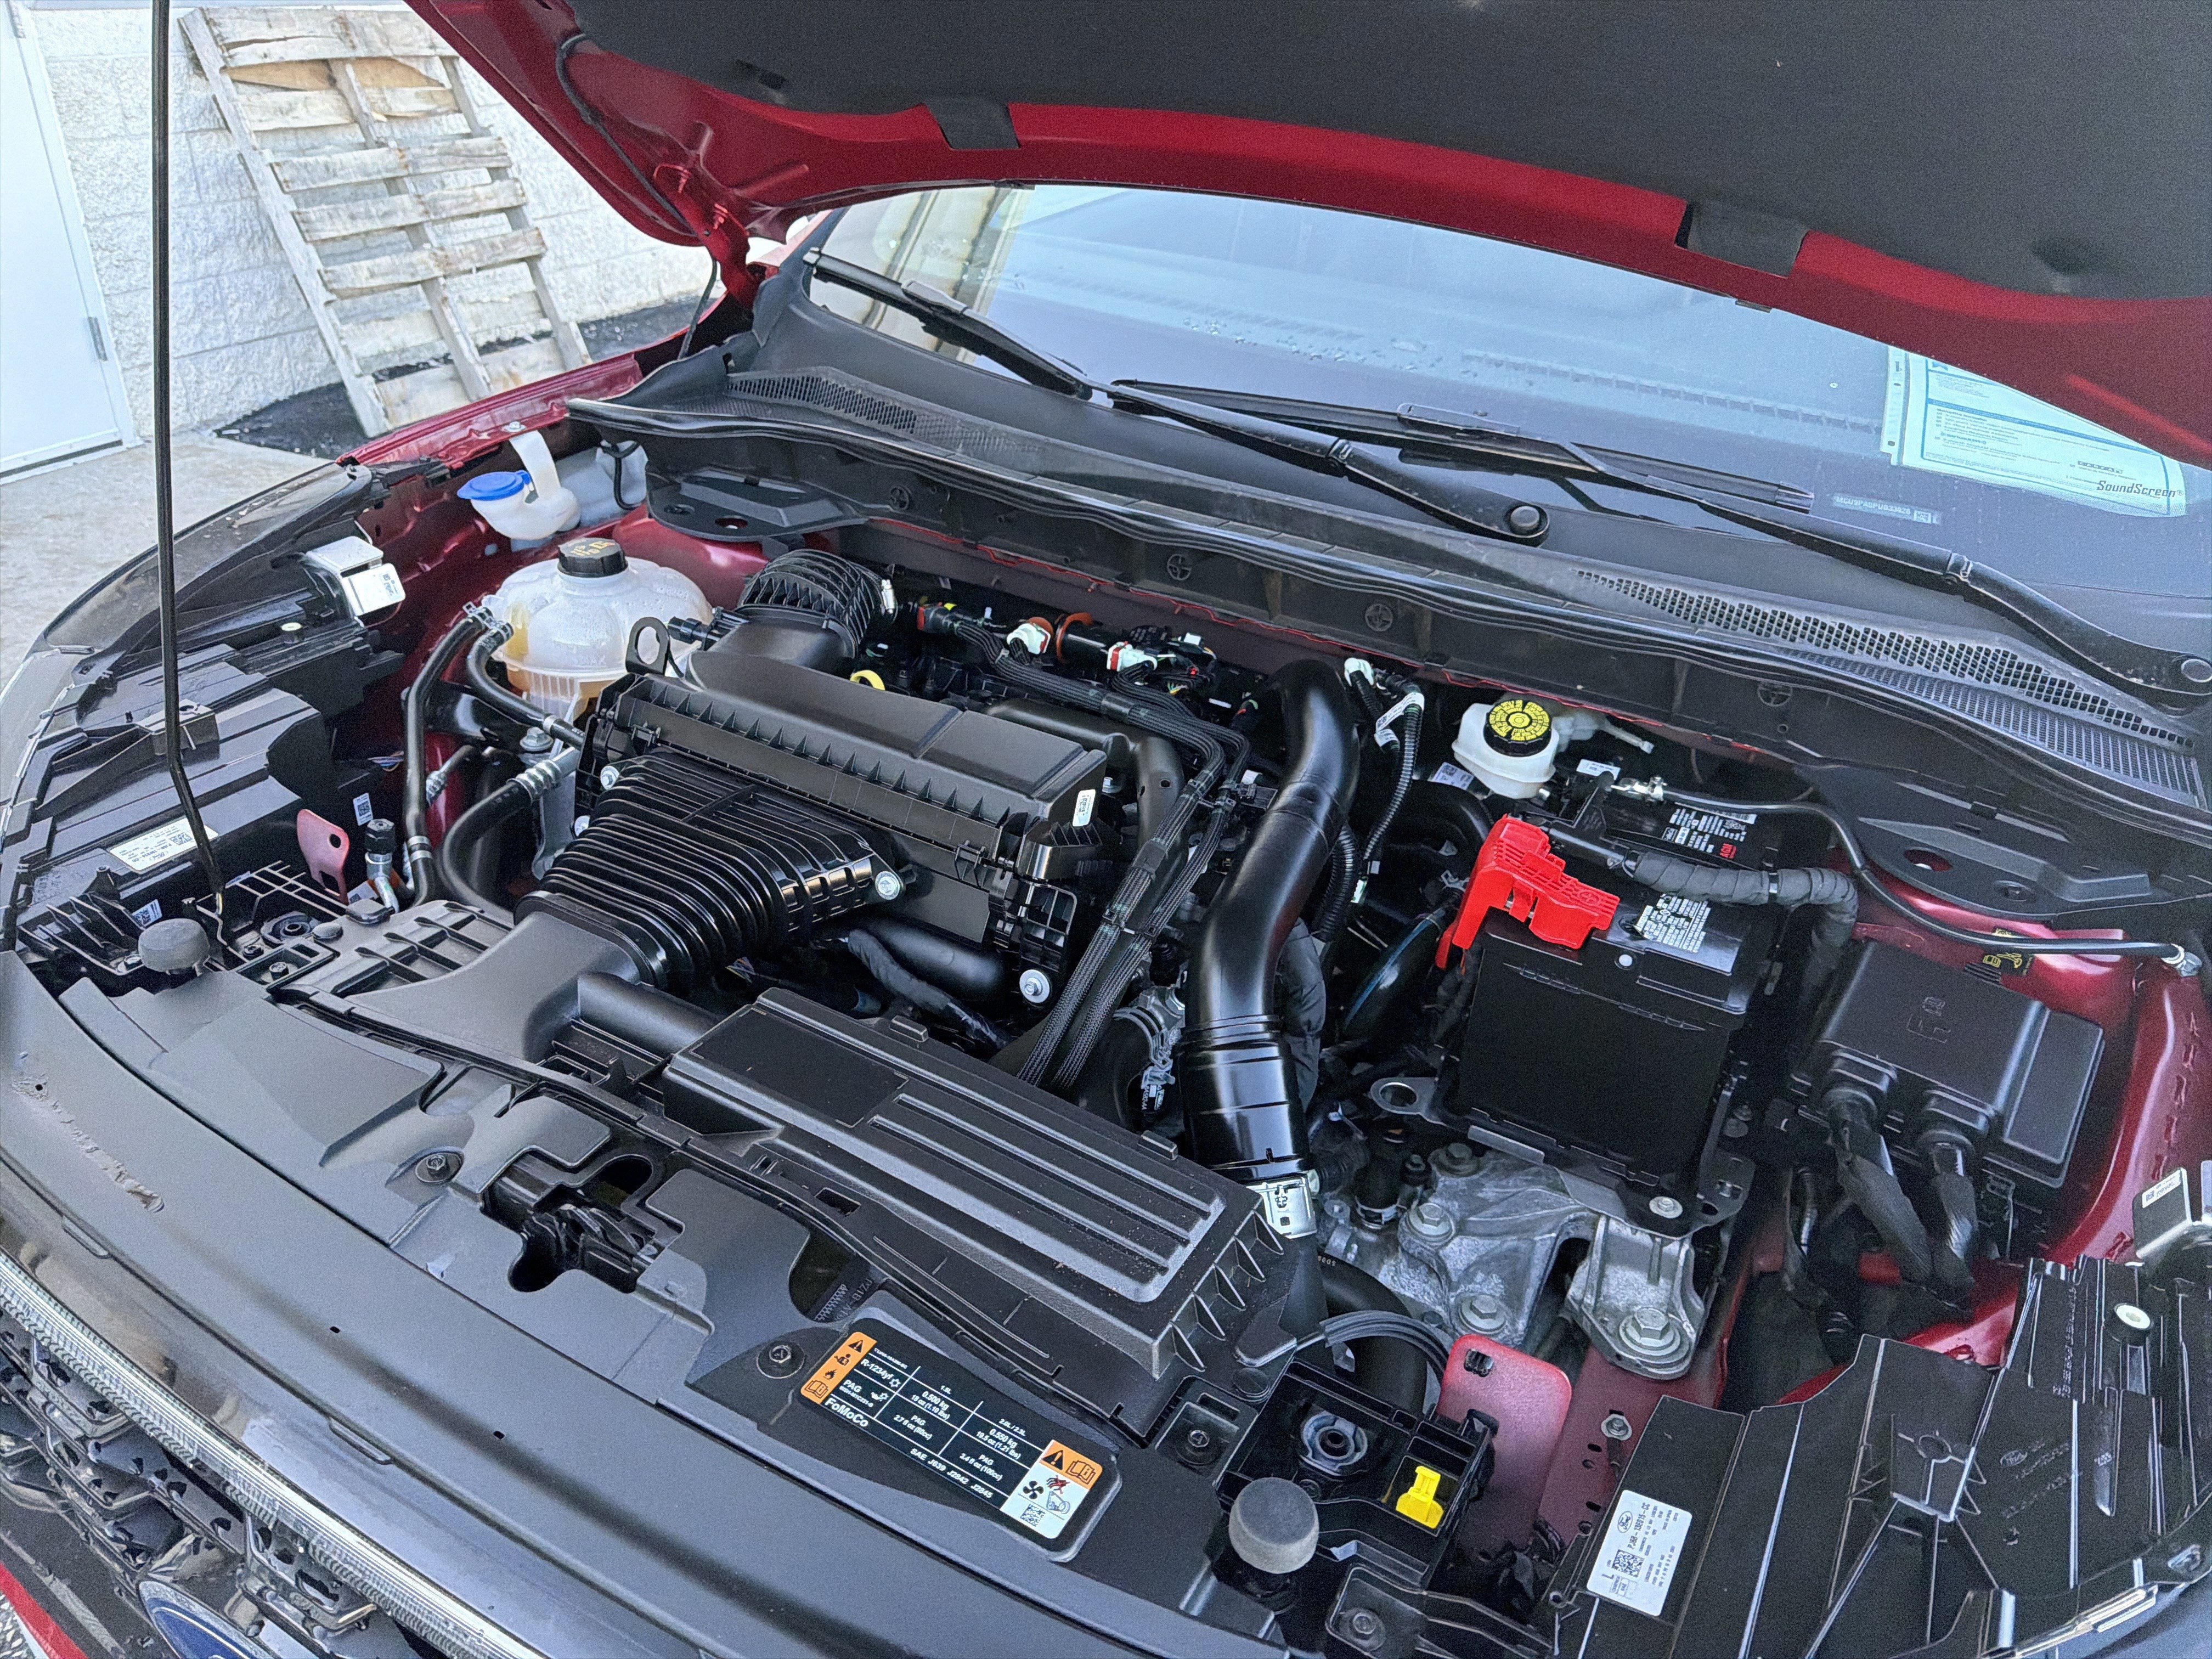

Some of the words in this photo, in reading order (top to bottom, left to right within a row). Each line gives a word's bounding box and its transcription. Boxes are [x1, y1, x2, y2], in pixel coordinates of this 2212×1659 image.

[861, 1359, 894, 1380] R-1234yf
[843, 1380, 862, 1393] PAG
[922, 1391, 940, 1404] 0.500
[939, 1401, 949, 1411] kg
[825, 1397, 868, 1427] FoMoCo
[894, 1414, 905, 1423] 2.7
[911, 1415, 926, 1426] PAG
[924, 1403, 939, 1413] (1.10
[938, 1410, 950, 1420] lbs)
[976, 1431, 989, 1441] 19.5
[994, 1442, 1010, 1452] (1.21
[1008, 1449, 1022, 1459] lbs)
[989, 1429, 1009, 1442] 0.550
[1007, 1438, 1018, 1449] kg
[960, 1453, 970, 1461] 3.4
[980, 1465, 1003, 1481] (100cc)
[978, 1454, 994, 1465] PAG
[910, 1448, 928, 1460] SAE
[927, 1459, 946, 1471] J639
[947, 1470, 969, 1485] J2842
[970, 1483, 994, 1498] J2845
[1618, 1513, 1632, 1532] Ford
